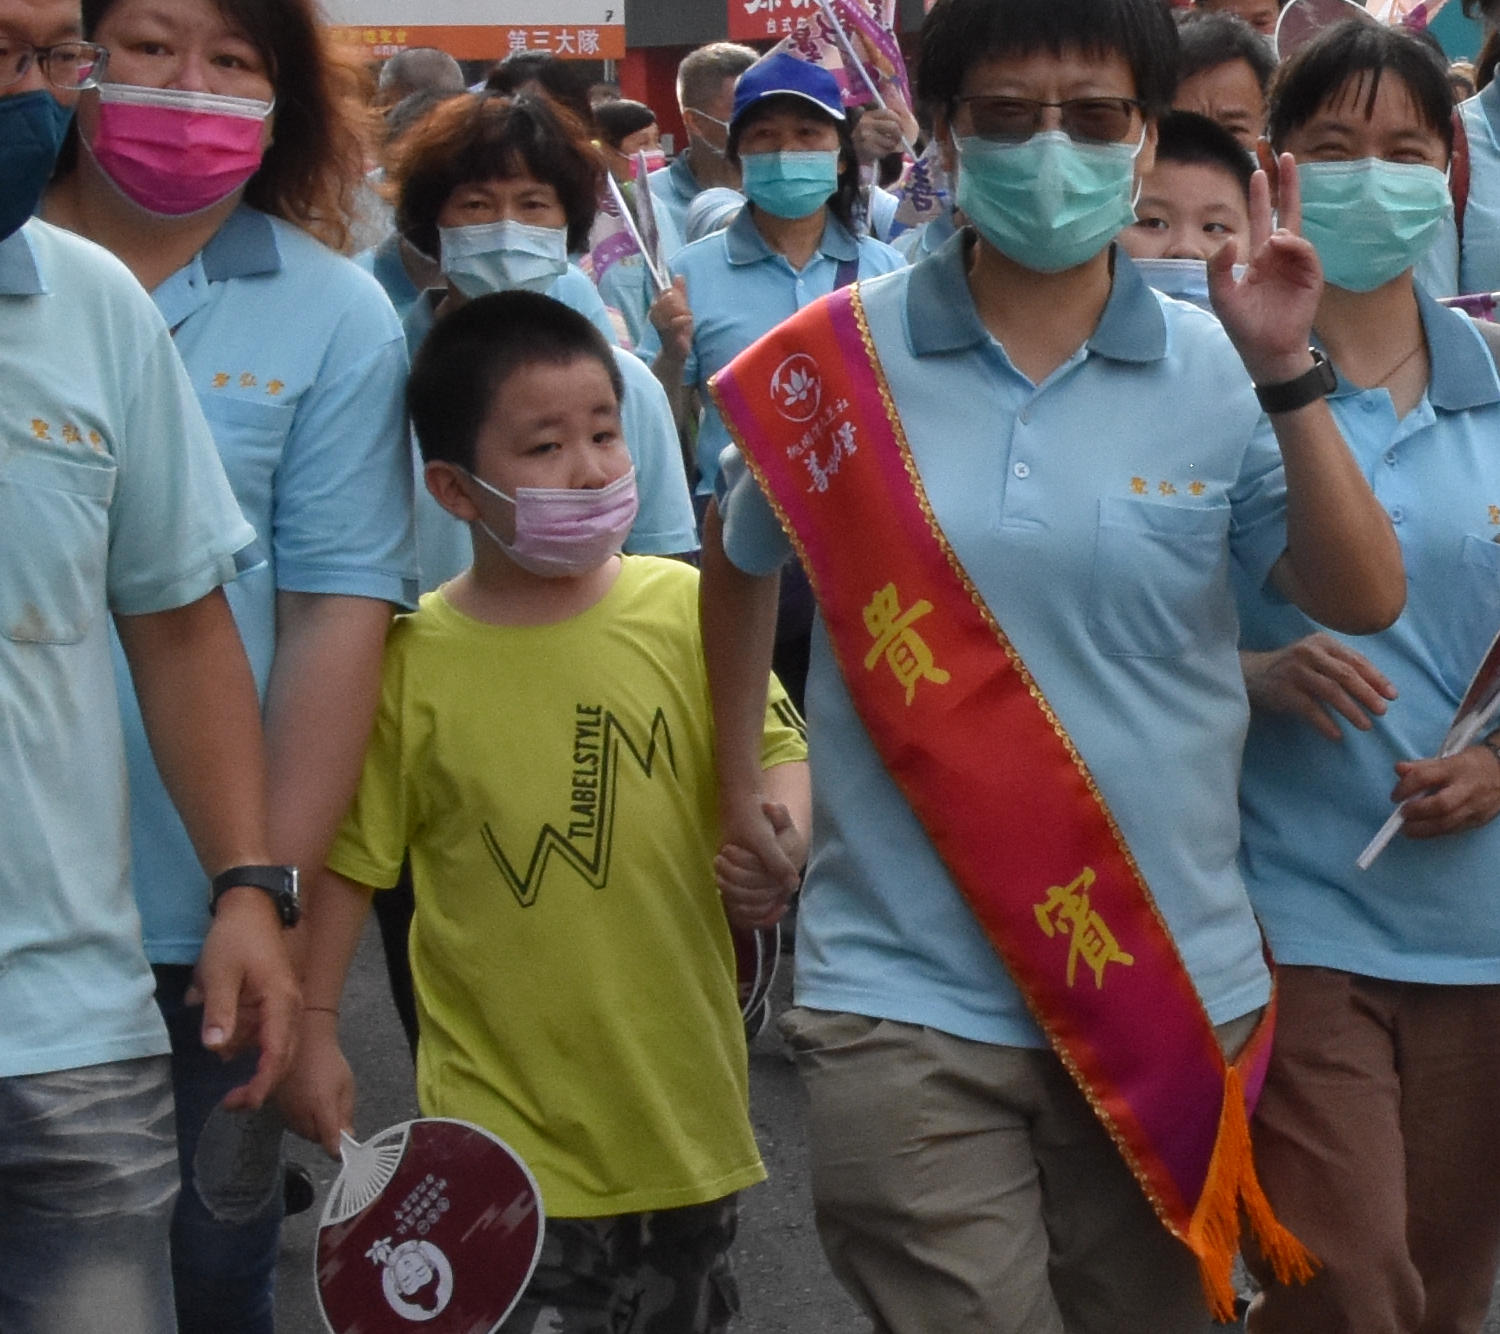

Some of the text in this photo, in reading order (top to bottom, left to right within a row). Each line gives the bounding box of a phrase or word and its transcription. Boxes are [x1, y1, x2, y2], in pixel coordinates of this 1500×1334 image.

[506, 29, 600, 56] 第三大隊
[567, 702, 603, 840] TLABELSTYLE
